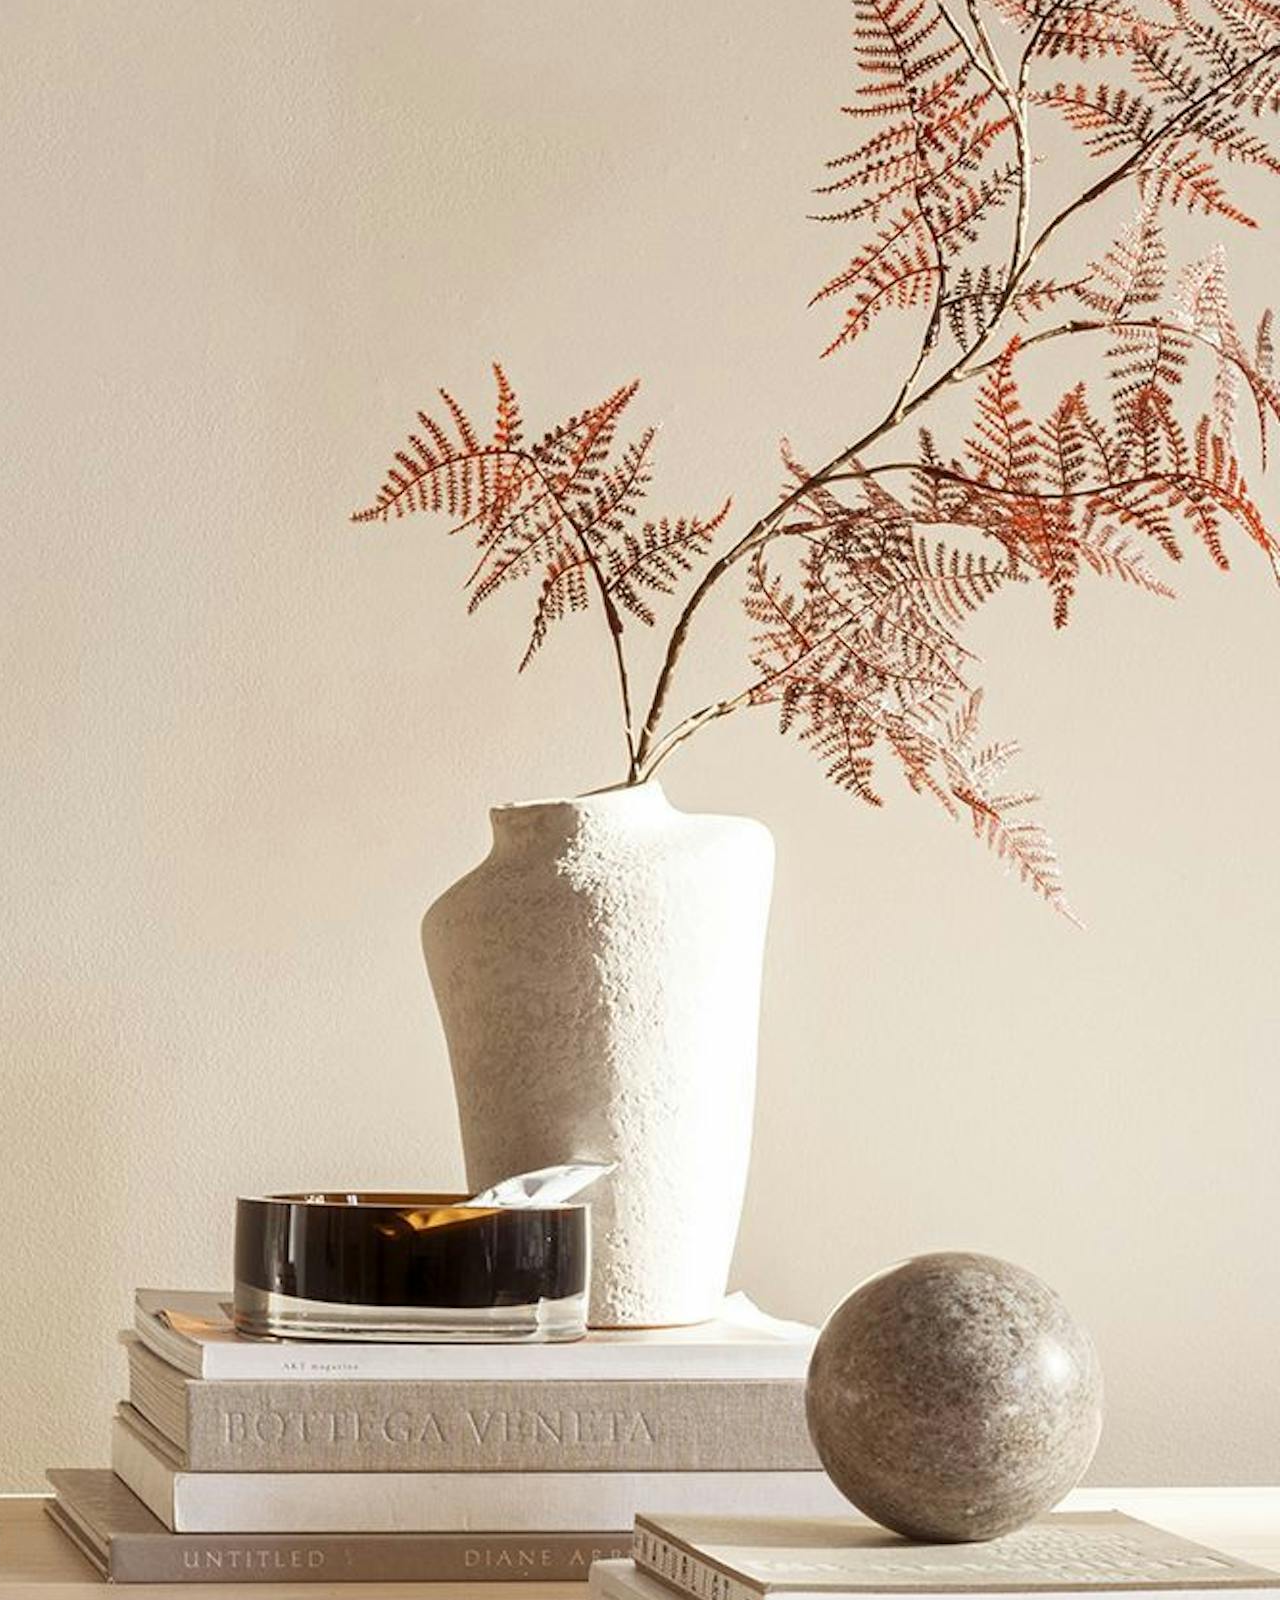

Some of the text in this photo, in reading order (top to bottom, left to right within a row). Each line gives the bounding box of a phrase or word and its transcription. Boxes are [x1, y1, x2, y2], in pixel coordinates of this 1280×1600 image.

[221, 1410, 658, 1445] BOTTEGA VENETA
[183, 1549, 326, 1569] UNTITLED
[464, 1548, 552, 1567] DIANE
